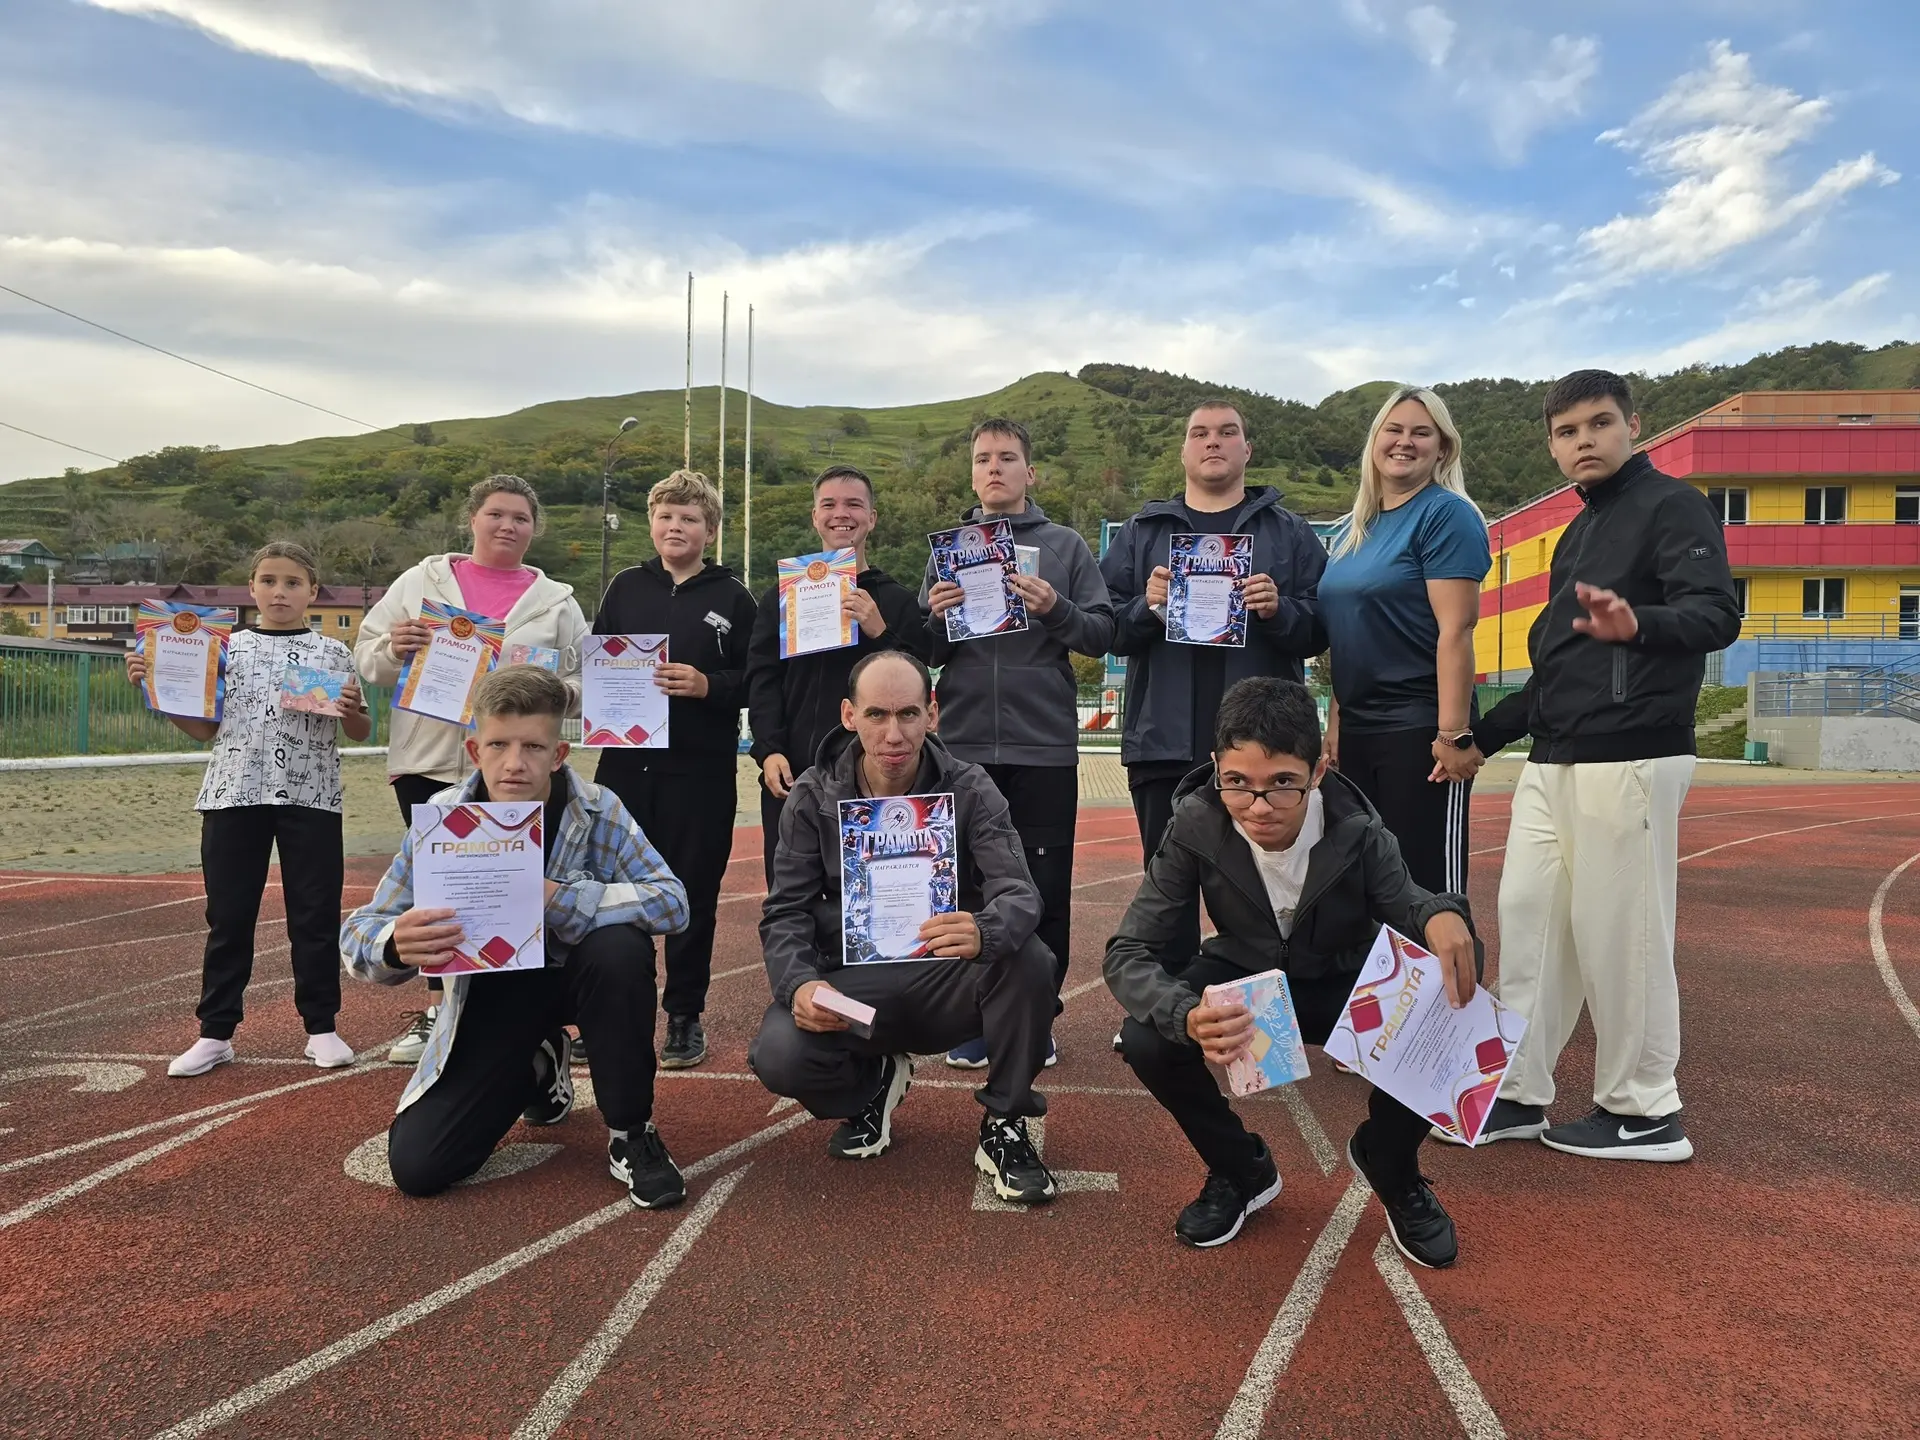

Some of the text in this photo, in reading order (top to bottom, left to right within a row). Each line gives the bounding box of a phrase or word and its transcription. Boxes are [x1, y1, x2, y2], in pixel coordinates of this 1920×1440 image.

[949, 545, 1004, 568] ГРАМОТА
[1183, 555, 1238, 572] ГРАМОТА
[799, 581, 836, 593] ГРАМОТА
[160, 635, 205, 647] ГРАМОТА
[436, 636, 477, 654] ГРАМОТА
[594, 658, 656, 668] ГРАМОТА
[431, 840, 525, 855] ГРАМОТА
[861, 829, 938, 856] ГРАМОТА
[874, 863, 920, 871] НАГРАЖДАЕТСЯ
[1368, 965, 1426, 1063] ГРАМОТА
